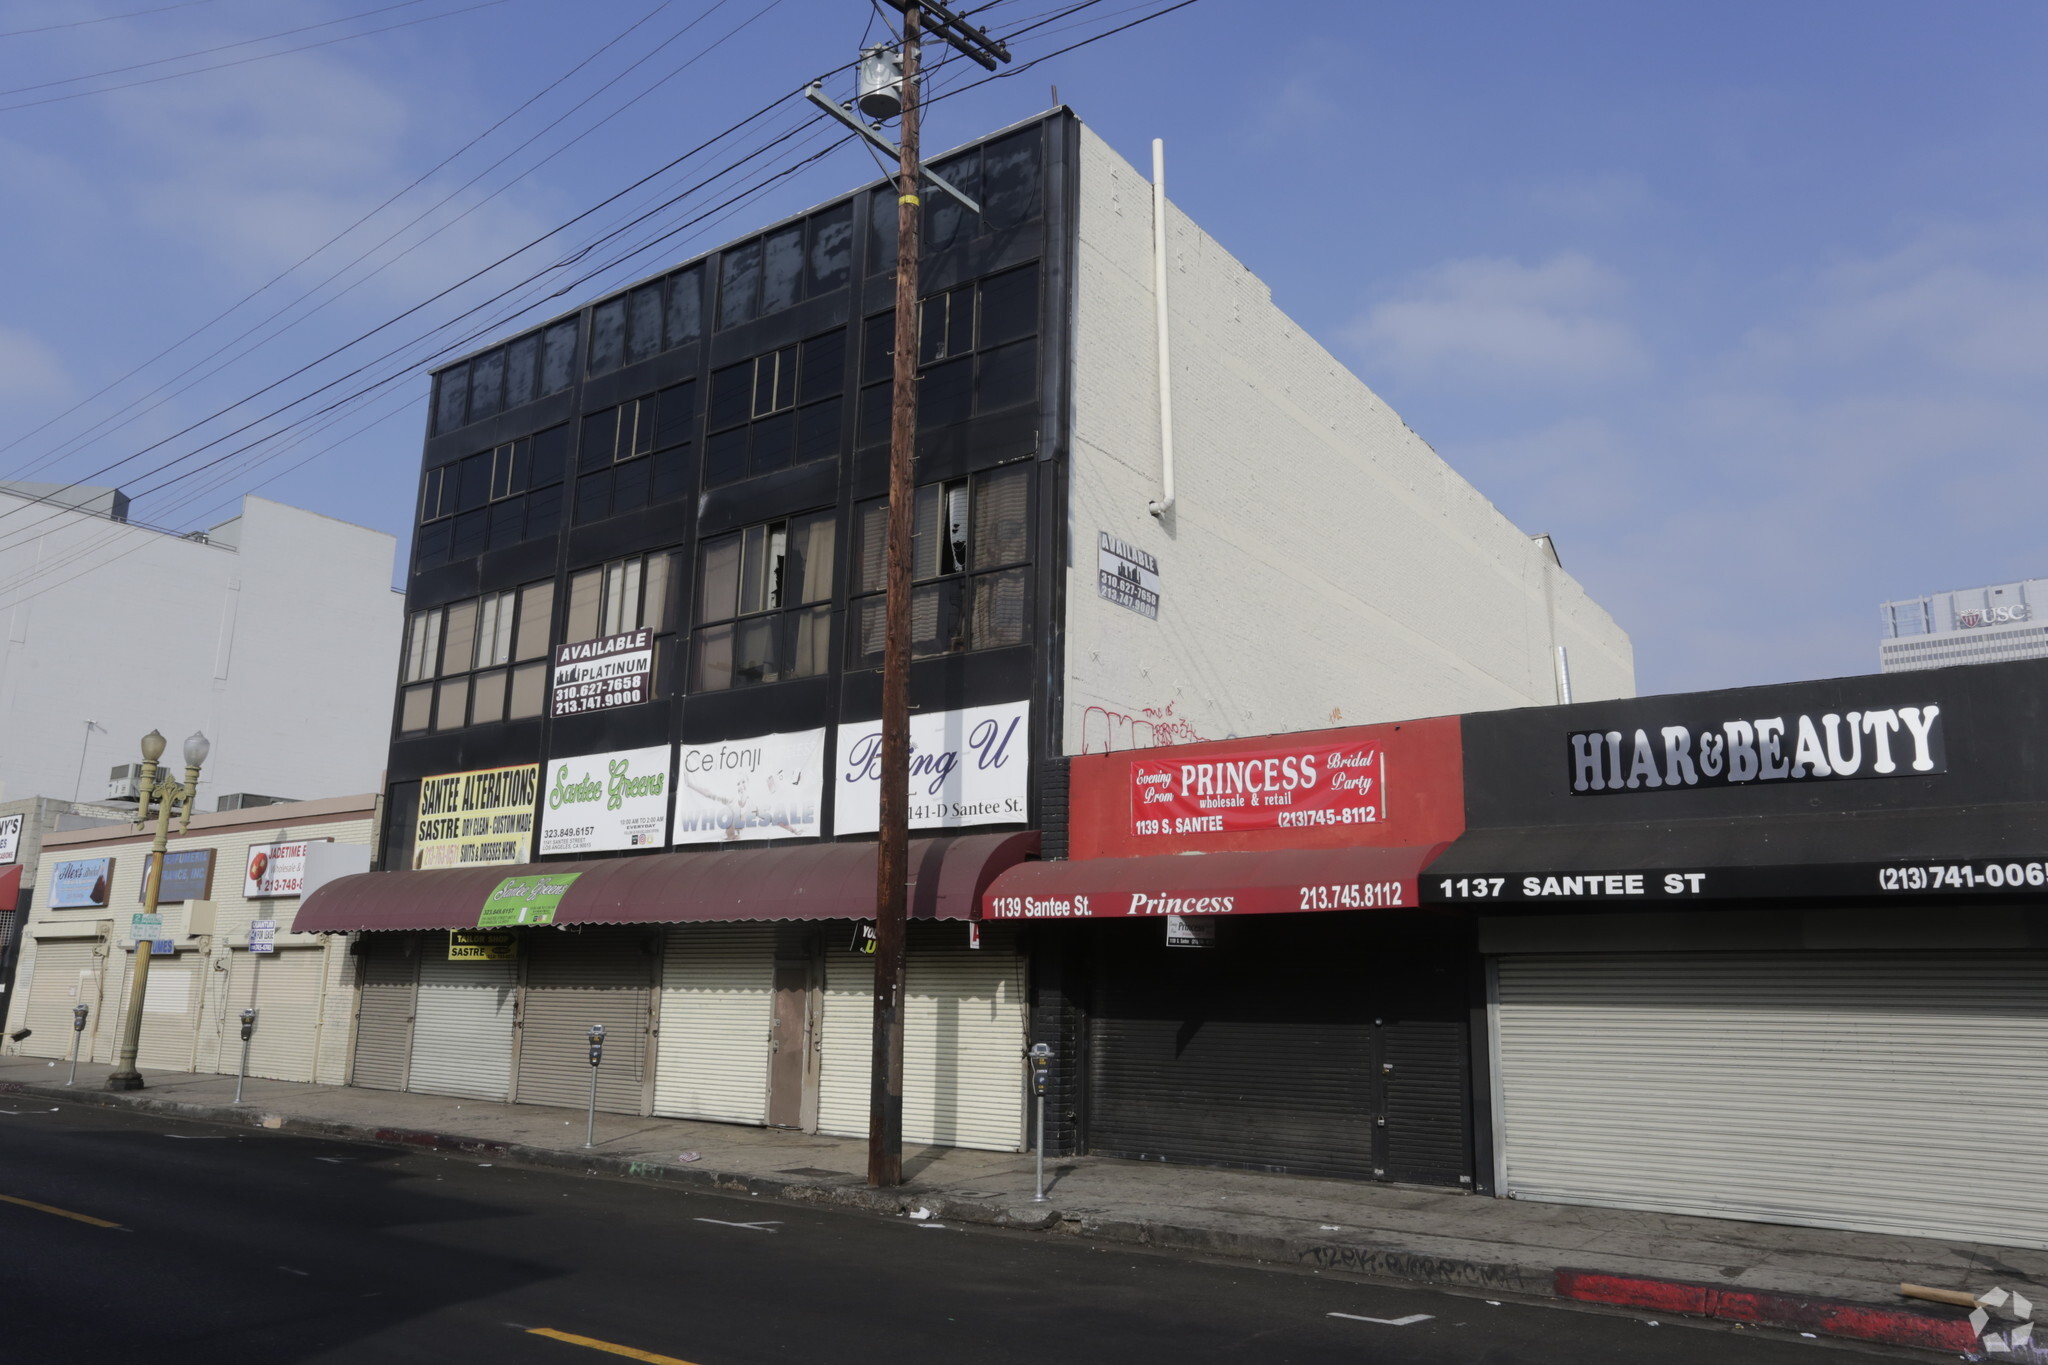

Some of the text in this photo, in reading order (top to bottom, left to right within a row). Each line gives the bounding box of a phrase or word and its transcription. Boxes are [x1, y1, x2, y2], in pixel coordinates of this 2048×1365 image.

[1101, 533, 1155, 571] AVAILABLE
[1101, 585, 1156, 617] 213.747.9000
[1981, 604, 2025, 624] USC
[560, 632, 647, 662] AVAILABLE
[581, 658, 648, 681] PLATINUM
[556, 675, 641, 702] 310.627-7658
[555, 689, 641, 715] 213.747.9000
[968, 715, 1021, 771] U
[1326, 750, 1375, 769] Bridal
[549, 758, 665, 811] Santee Greens
[1136, 768, 1172, 789] Evening
[1180, 754, 1317, 797] PRINCESS
[1331, 771, 1374, 795] Party
[421, 767, 536, 816] SANTEE ALTERATIONS
[1143, 787, 1174, 804] Prom
[1199, 791, 1292, 809] wholesale & retail
[682, 804, 814, 832] WHOLESALE
[951, 801, 1000, 817] Santee
[1004, 798, 1023, 813] St.
[418, 817, 460, 841] SASTRE
[461, 818, 473, 837] DRY
[473, 816, 490, 836] CLEAN
[492, 814, 515, 835] CUSTOM
[515, 813, 532, 833] MADE
[544, 826, 595, 839] 323.849.6157
[1136, 820, 1159, 835] 1139
[1175, 815, 1223, 834] SANTEE
[269, 845, 300, 859] JADETIME
[460, 843, 475, 863] SUITS
[479, 841, 502, 861] DRESSES
[501, 840, 517, 860] HEMS
[493, 877, 569, 902] Santee Greens
[1299, 881, 1403, 911] 213.745.8112
[1440, 872, 1706, 898] 1137 SANTEE ST
[992, 895, 1093, 918] 1139 Santee St.
[1127, 892, 1235, 915] Princess
[451, 947, 485, 957] SASTRE
